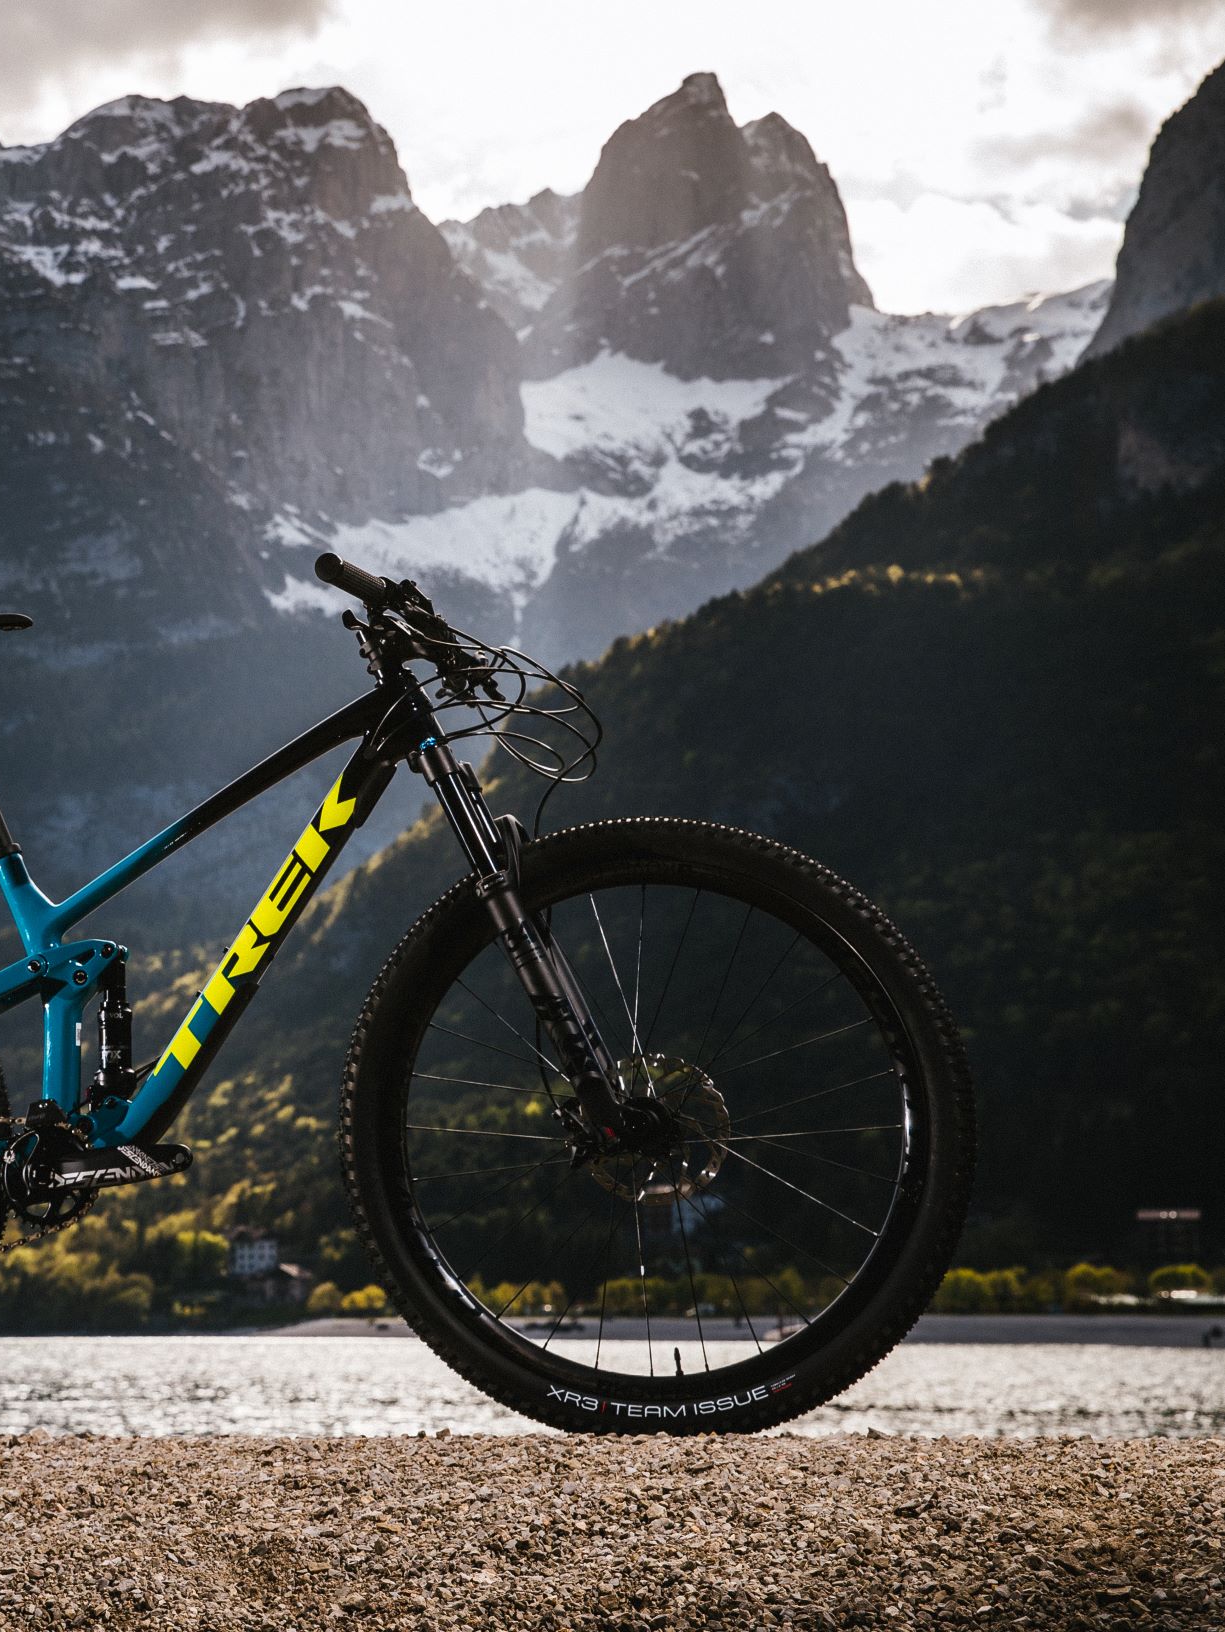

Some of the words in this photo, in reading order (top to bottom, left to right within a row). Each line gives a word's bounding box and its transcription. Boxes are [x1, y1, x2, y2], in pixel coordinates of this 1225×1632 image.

[154, 773, 357, 1077] TREK
[546, 1384, 599, 1410] XR3
[610, 1402, 688, 1418] TEAM
[693, 1385, 769, 1416] ISSUE
